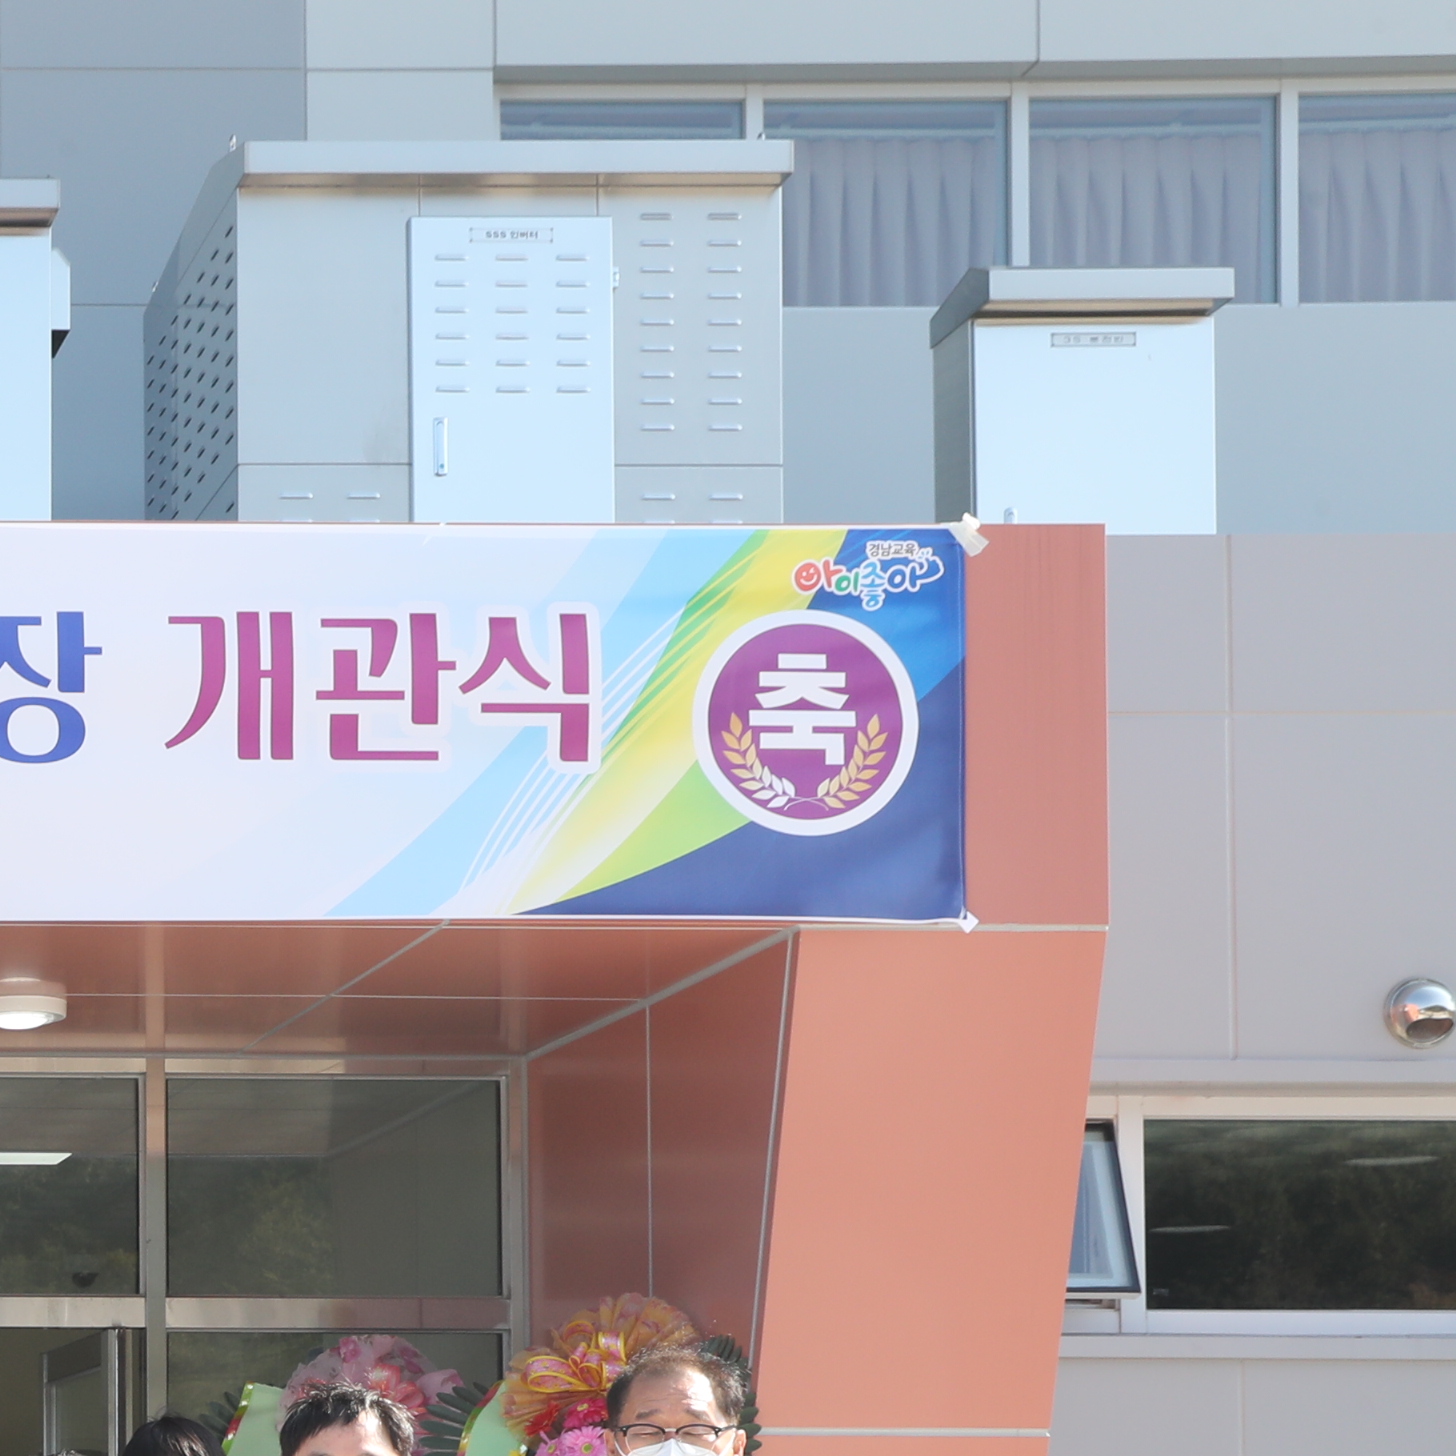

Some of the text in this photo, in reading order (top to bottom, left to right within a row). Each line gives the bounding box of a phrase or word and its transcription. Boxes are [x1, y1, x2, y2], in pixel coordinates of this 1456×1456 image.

[793, 556, 941, 611] 아이좋아
[868, 542, 917, 557] 경남교육
[165, 610, 592, 764] 개관식
[748, 653, 857, 765] 축
